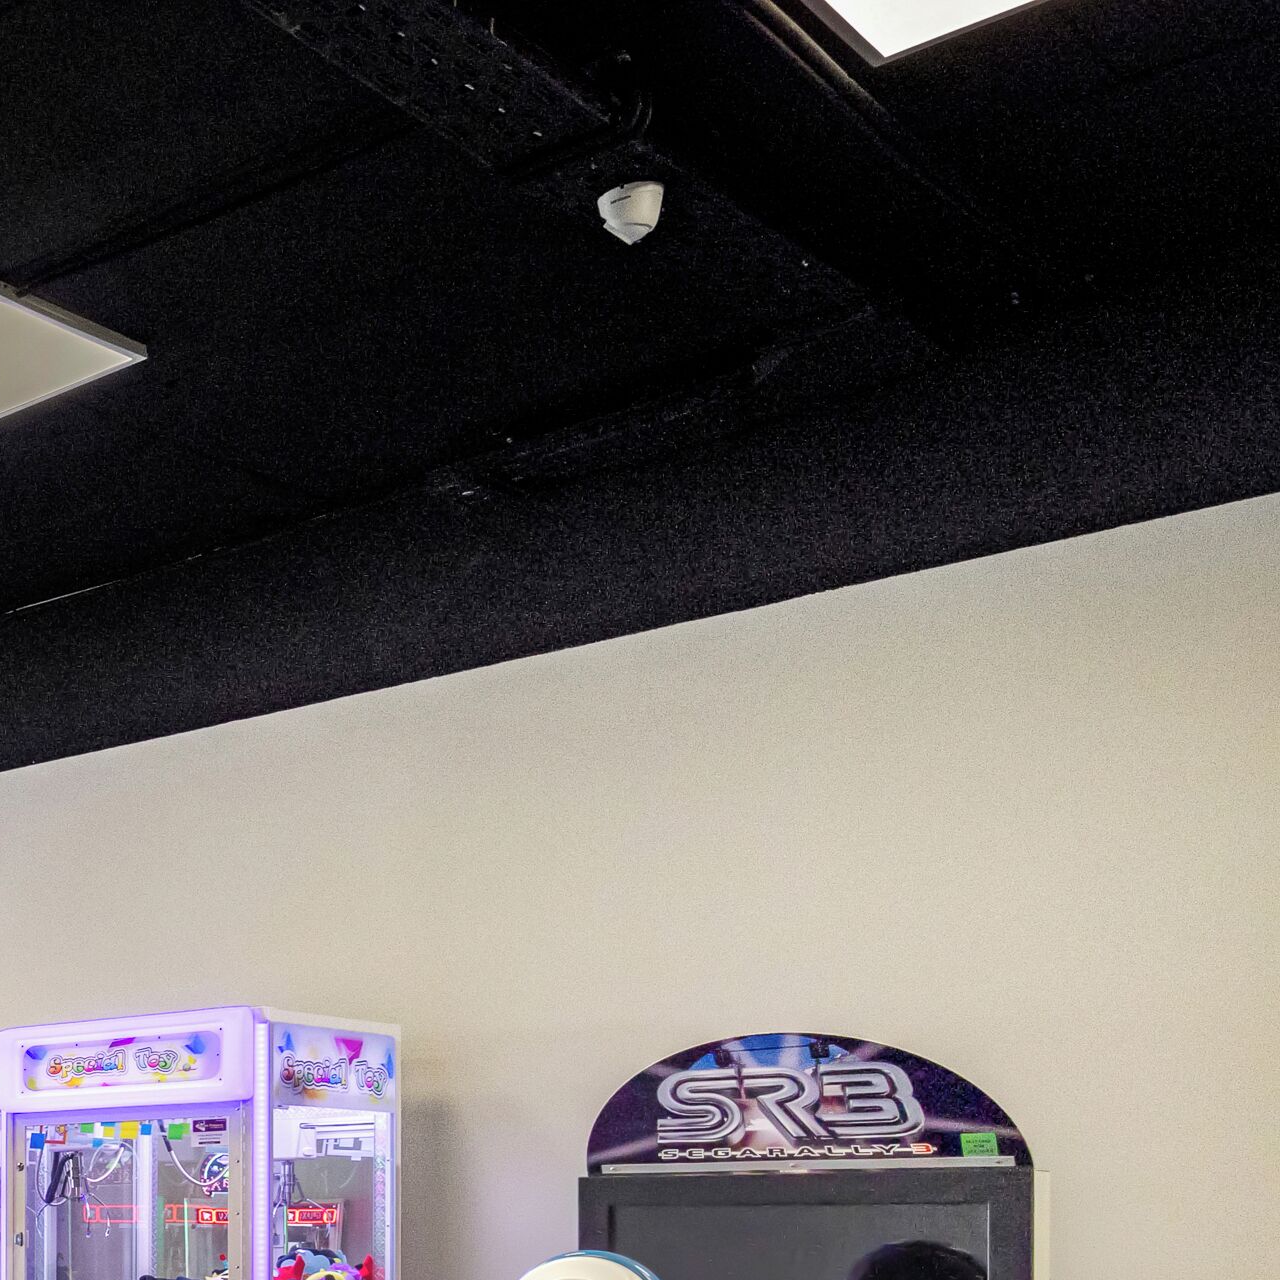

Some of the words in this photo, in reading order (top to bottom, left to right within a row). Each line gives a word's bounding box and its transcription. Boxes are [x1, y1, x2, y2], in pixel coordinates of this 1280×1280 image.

[47, 1049, 126, 1082] Special
[136, 1047, 180, 1072] Toy
[280, 1054, 348, 1092] Special
[355, 1061, 391, 1096] Toy
